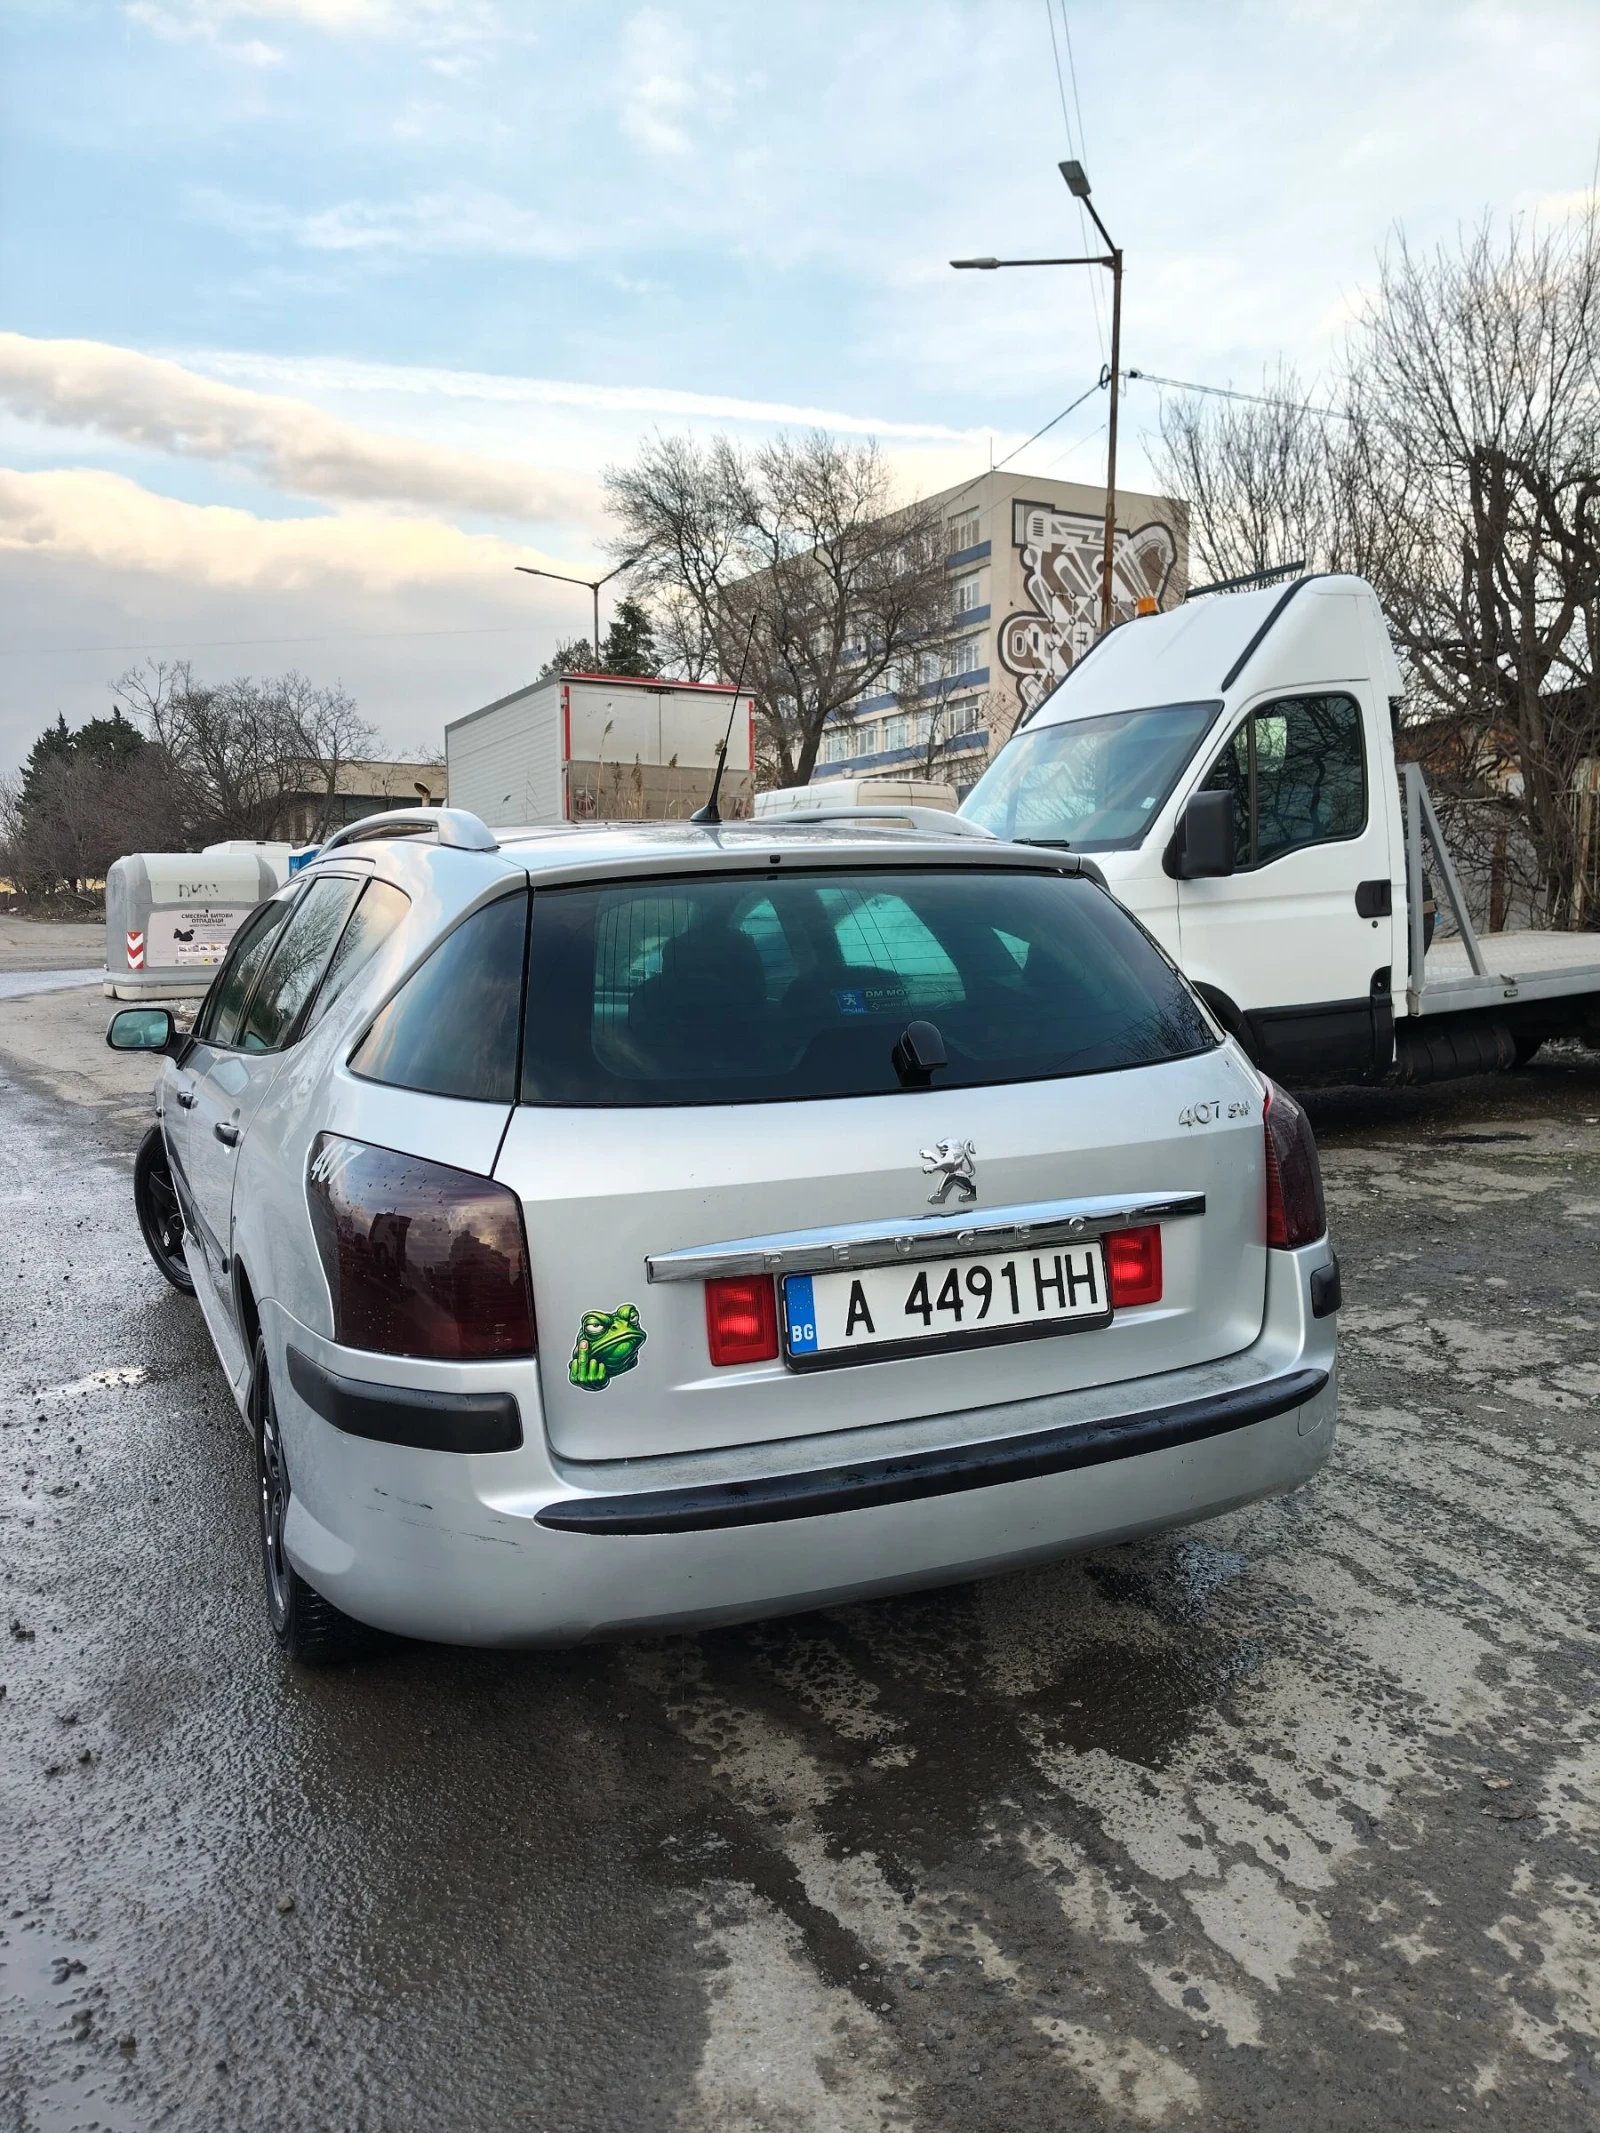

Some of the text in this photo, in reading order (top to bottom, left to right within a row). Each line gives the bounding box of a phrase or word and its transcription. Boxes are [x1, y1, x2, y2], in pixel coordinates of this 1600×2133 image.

[865, 989, 883, 998] DM
[1178, 1100, 1220, 1127] 407
[310, 1137, 366, 1185] 407
[763, 1208, 1137, 1271] PEUGEOT
[845, 1251, 1099, 1337] A 4491 HH
[791, 1324, 814, 1343] BG
